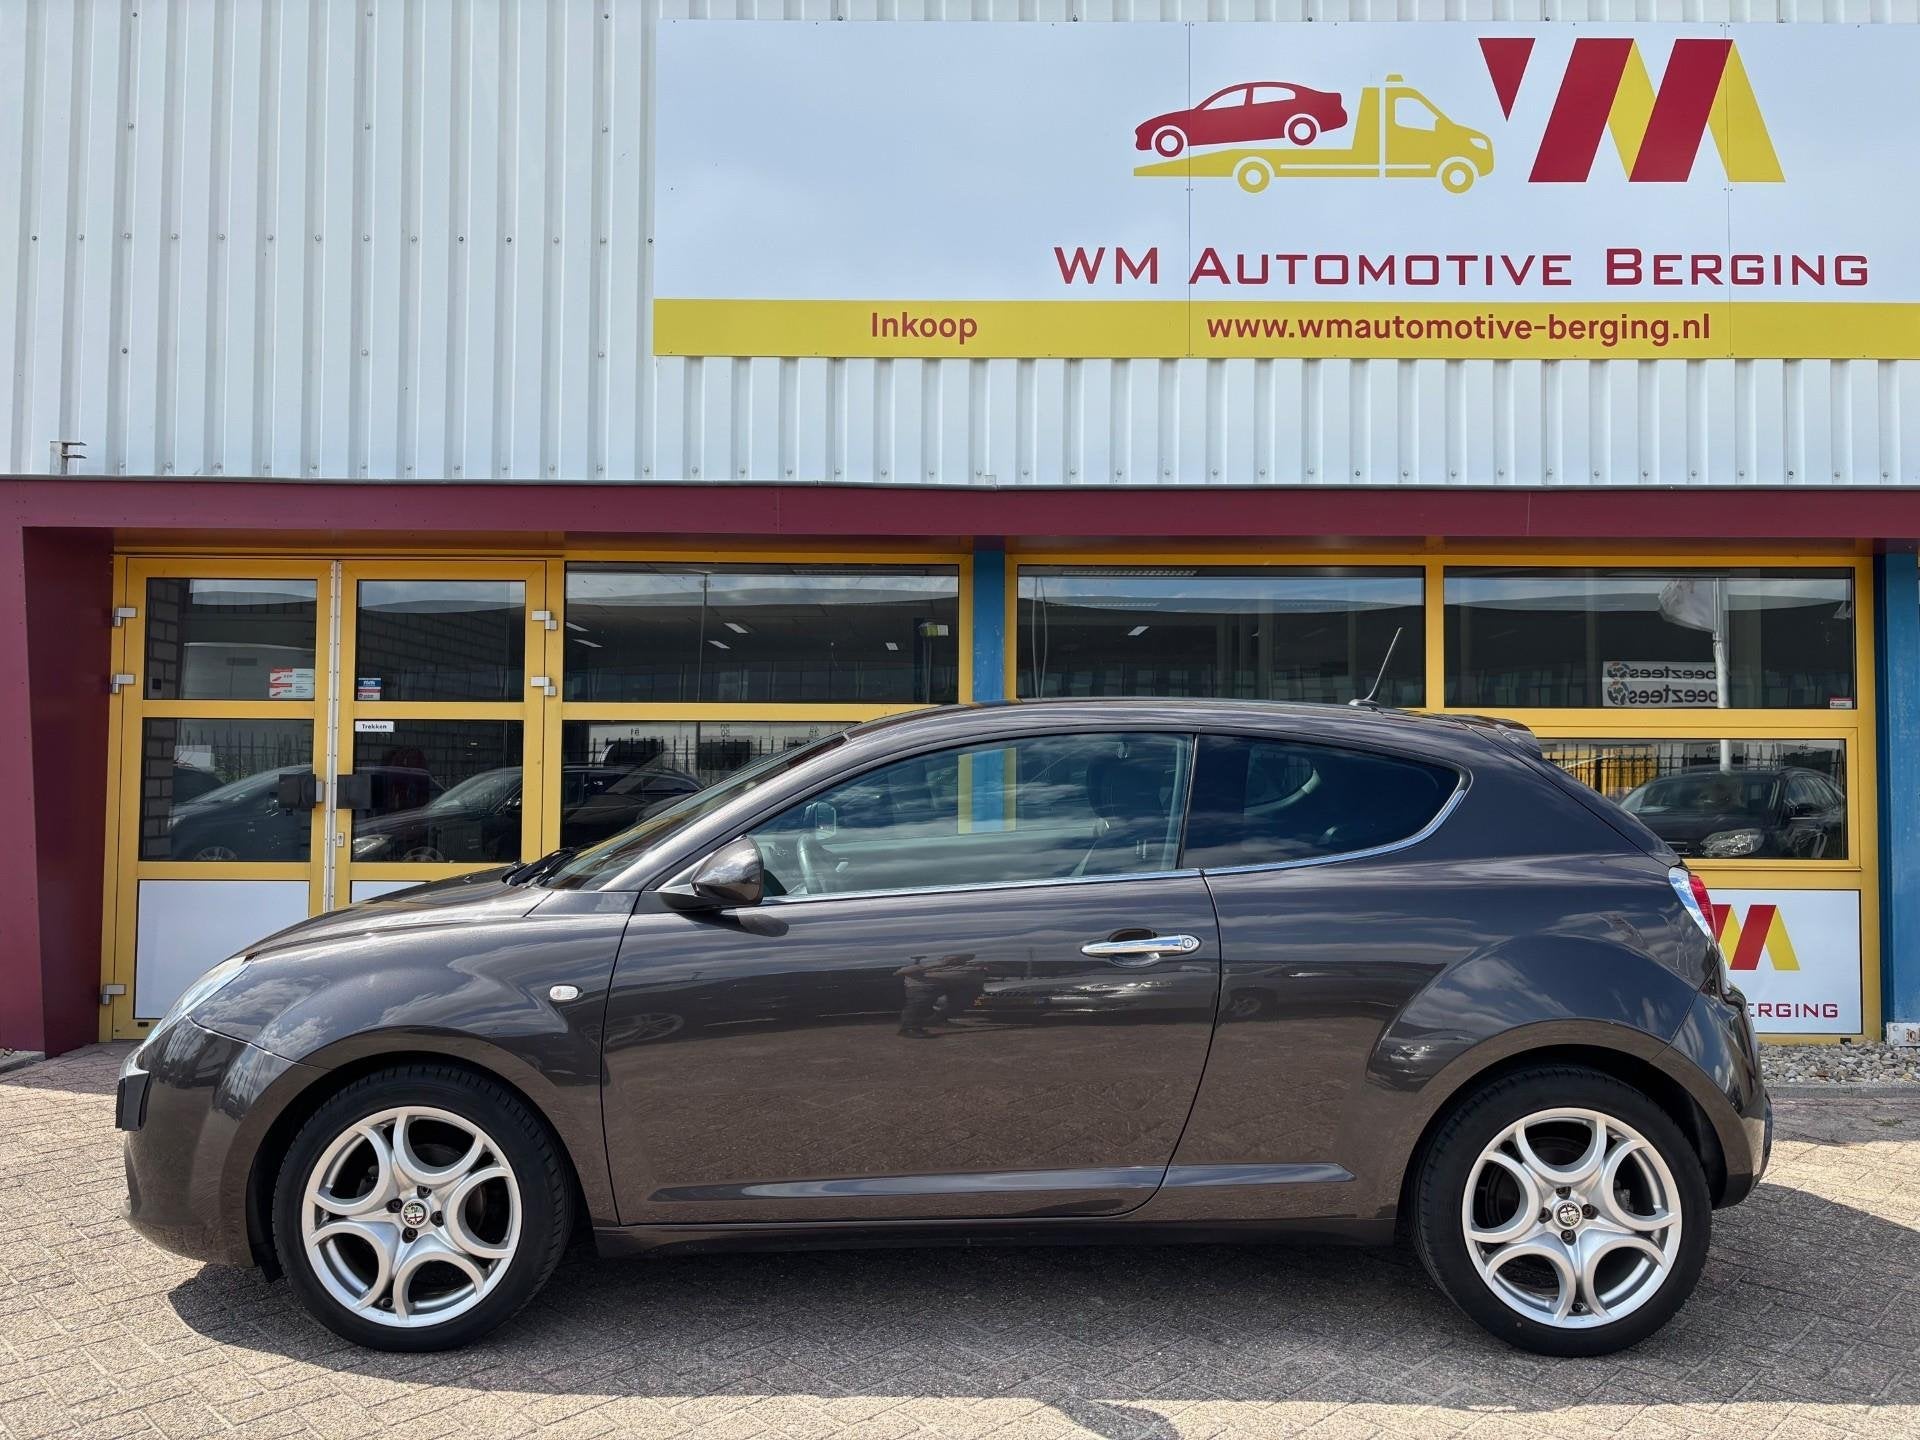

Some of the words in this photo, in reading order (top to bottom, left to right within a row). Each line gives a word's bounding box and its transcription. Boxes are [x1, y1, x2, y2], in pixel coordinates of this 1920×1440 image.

[1055, 247, 1159, 285] WM
[872, 311, 978, 345] Inkoop
[1207, 313, 1711, 347] www.wmautomotive-berging.nl
